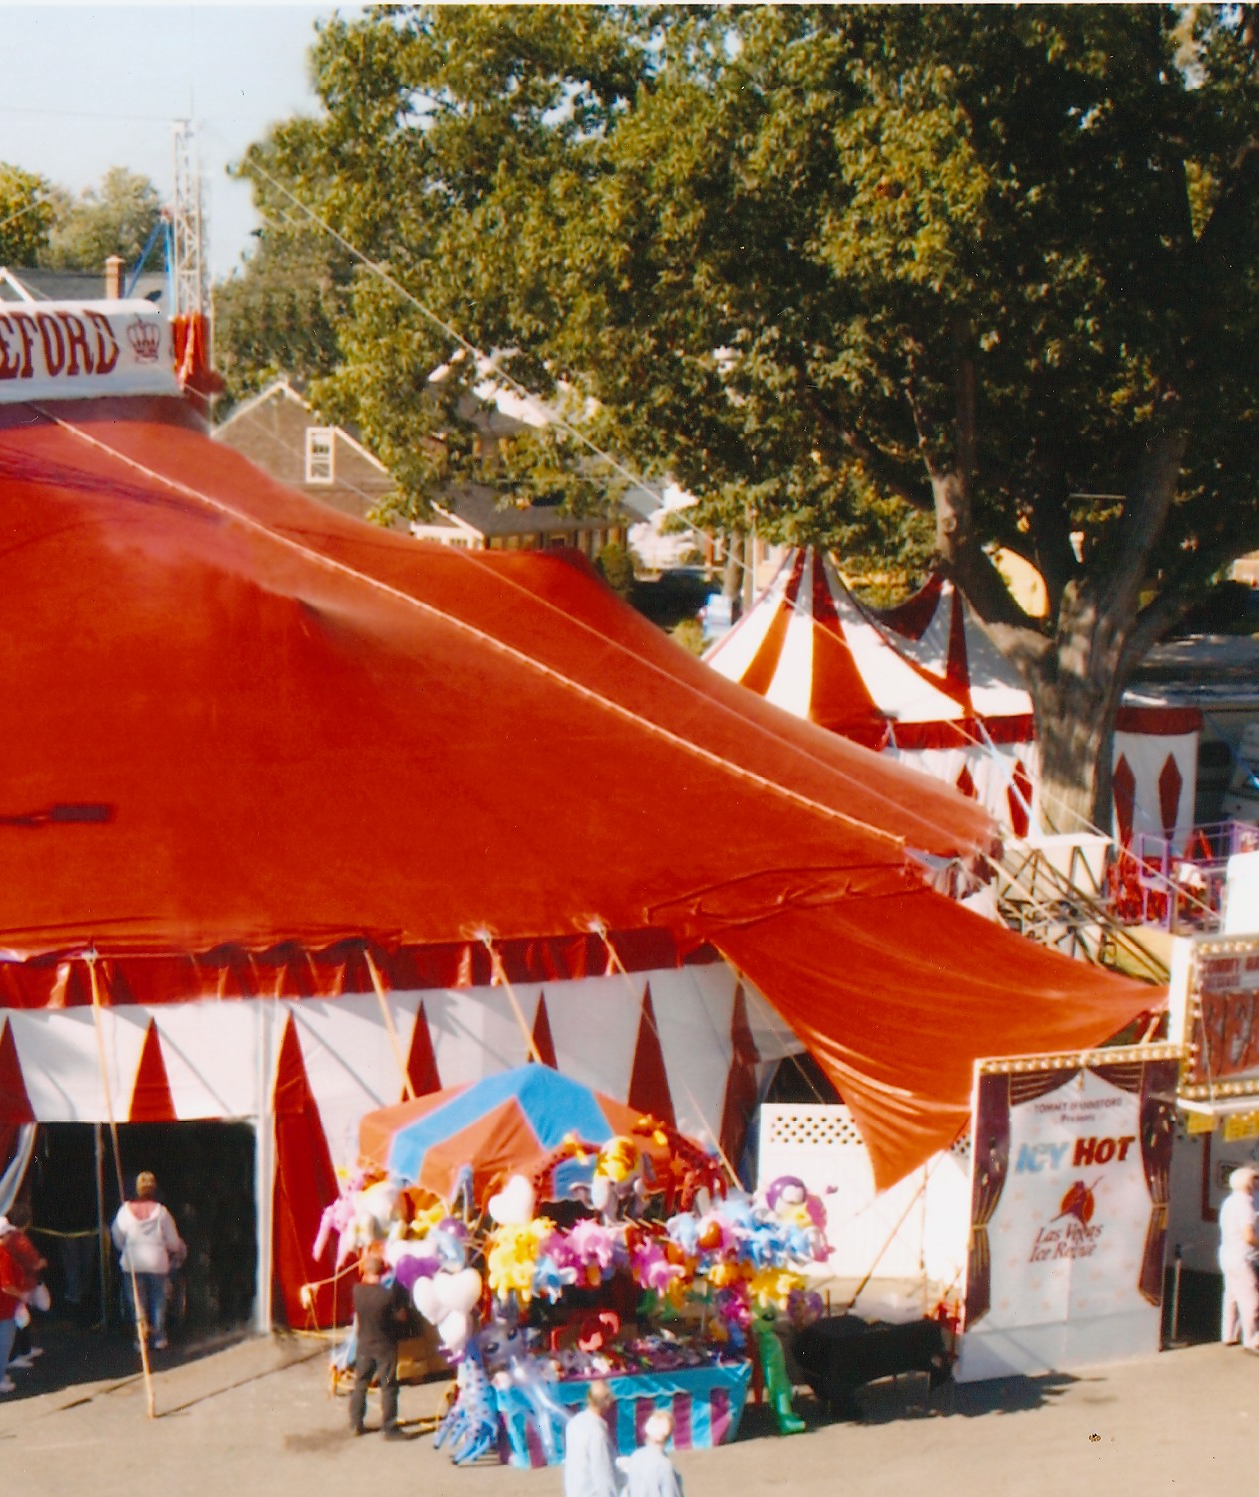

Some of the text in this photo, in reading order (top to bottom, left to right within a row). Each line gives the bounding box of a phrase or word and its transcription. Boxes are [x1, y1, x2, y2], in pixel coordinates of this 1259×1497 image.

[1015, 1135, 1135, 1173] ICY HOT
[1035, 1225, 1063, 1244] Las
